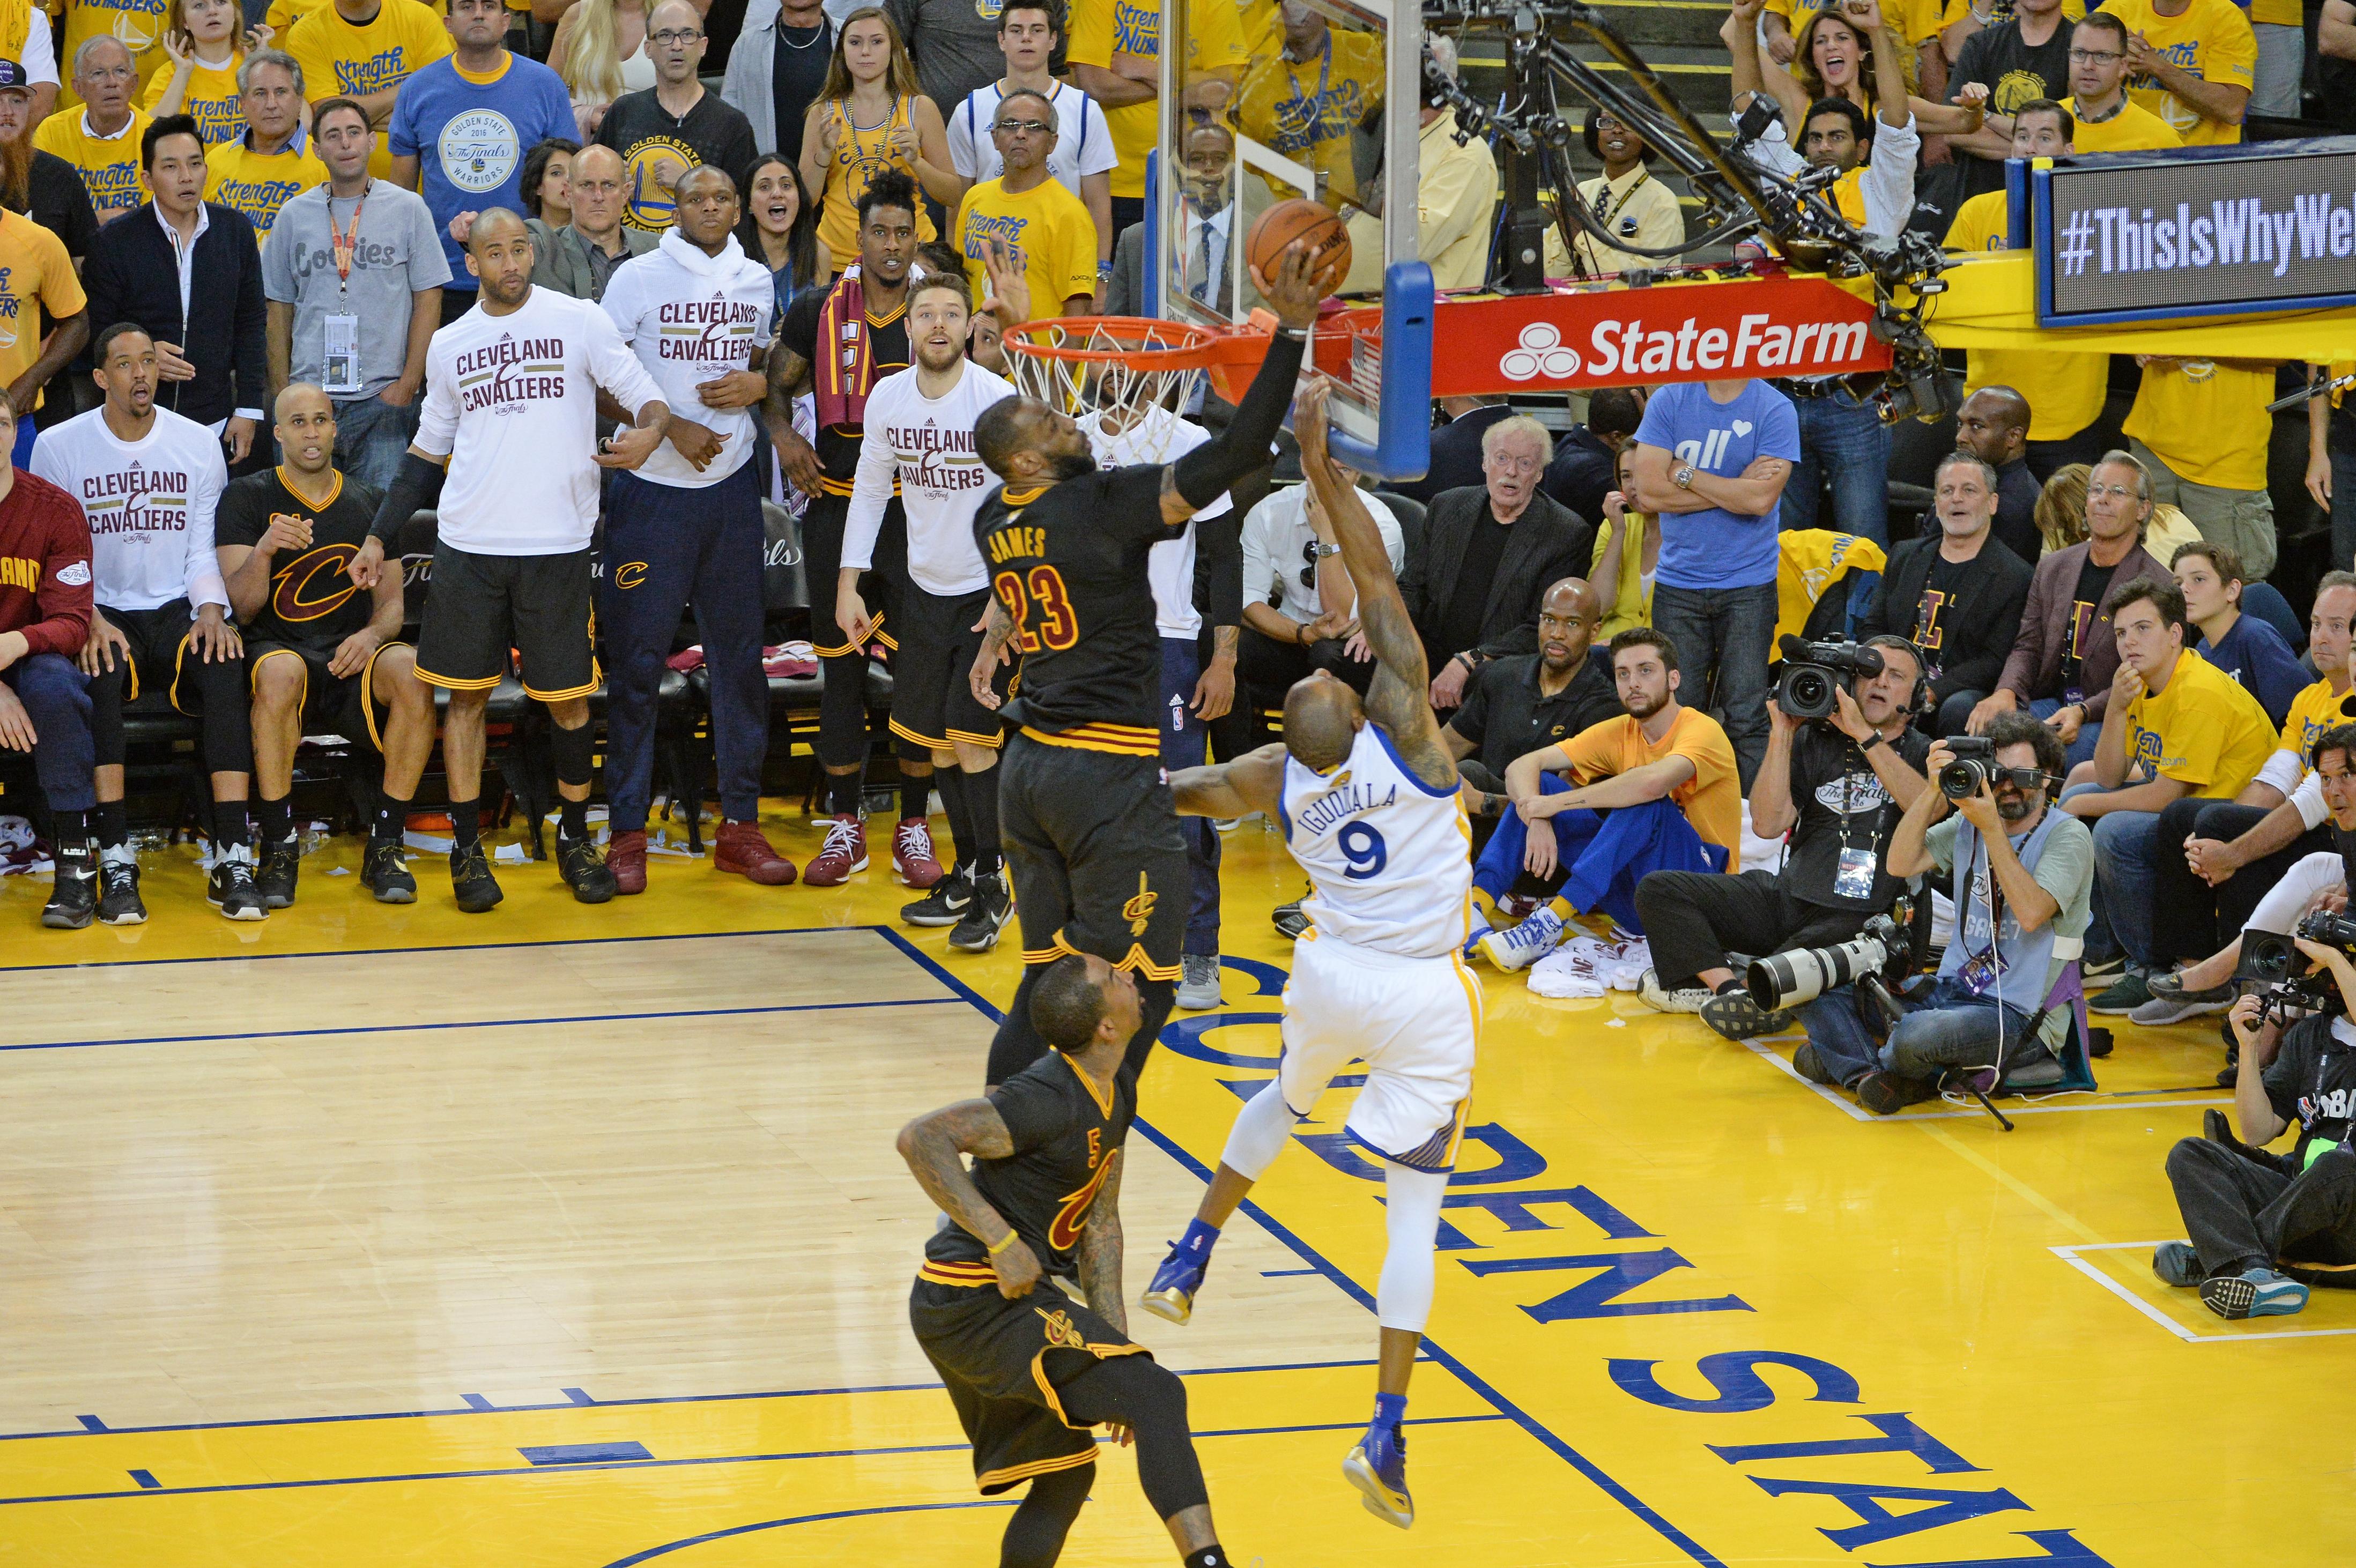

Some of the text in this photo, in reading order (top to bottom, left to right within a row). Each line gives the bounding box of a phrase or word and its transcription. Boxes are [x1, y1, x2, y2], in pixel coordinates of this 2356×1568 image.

[1114, 0, 1159, 38] Stren
[451, 117, 506, 136] GOLDEN STATE
[456, 143, 509, 162] Finals
[624, 135, 703, 168] GOLDEN STATE
[454, 167, 503, 184] WARRIORS
[217, 179, 301, 210] Strength
[2059, 192, 2356, 278] #ThisIsWhyWe
[660, 301, 757, 323] CLEVELAND
[456, 338, 564, 376] CLEVELAND
[660, 338, 753, 361] CAVALIERS
[1587, 314, 1868, 375] State Farm
[463, 376, 564, 412] CAVALIERS
[887, 427, 981, 453] CLEVELAND
[83, 470, 187, 499] CLEVELAND
[88, 509, 187, 534] CAVALIERS
[988, 526, 1046, 563] JAMES
[995, 564, 1079, 653] 23
[1298, 783, 1397, 837] IGUODALA
[1338, 820, 1387, 880] 9
[1602, 1350, 2118, 1568] STAT
